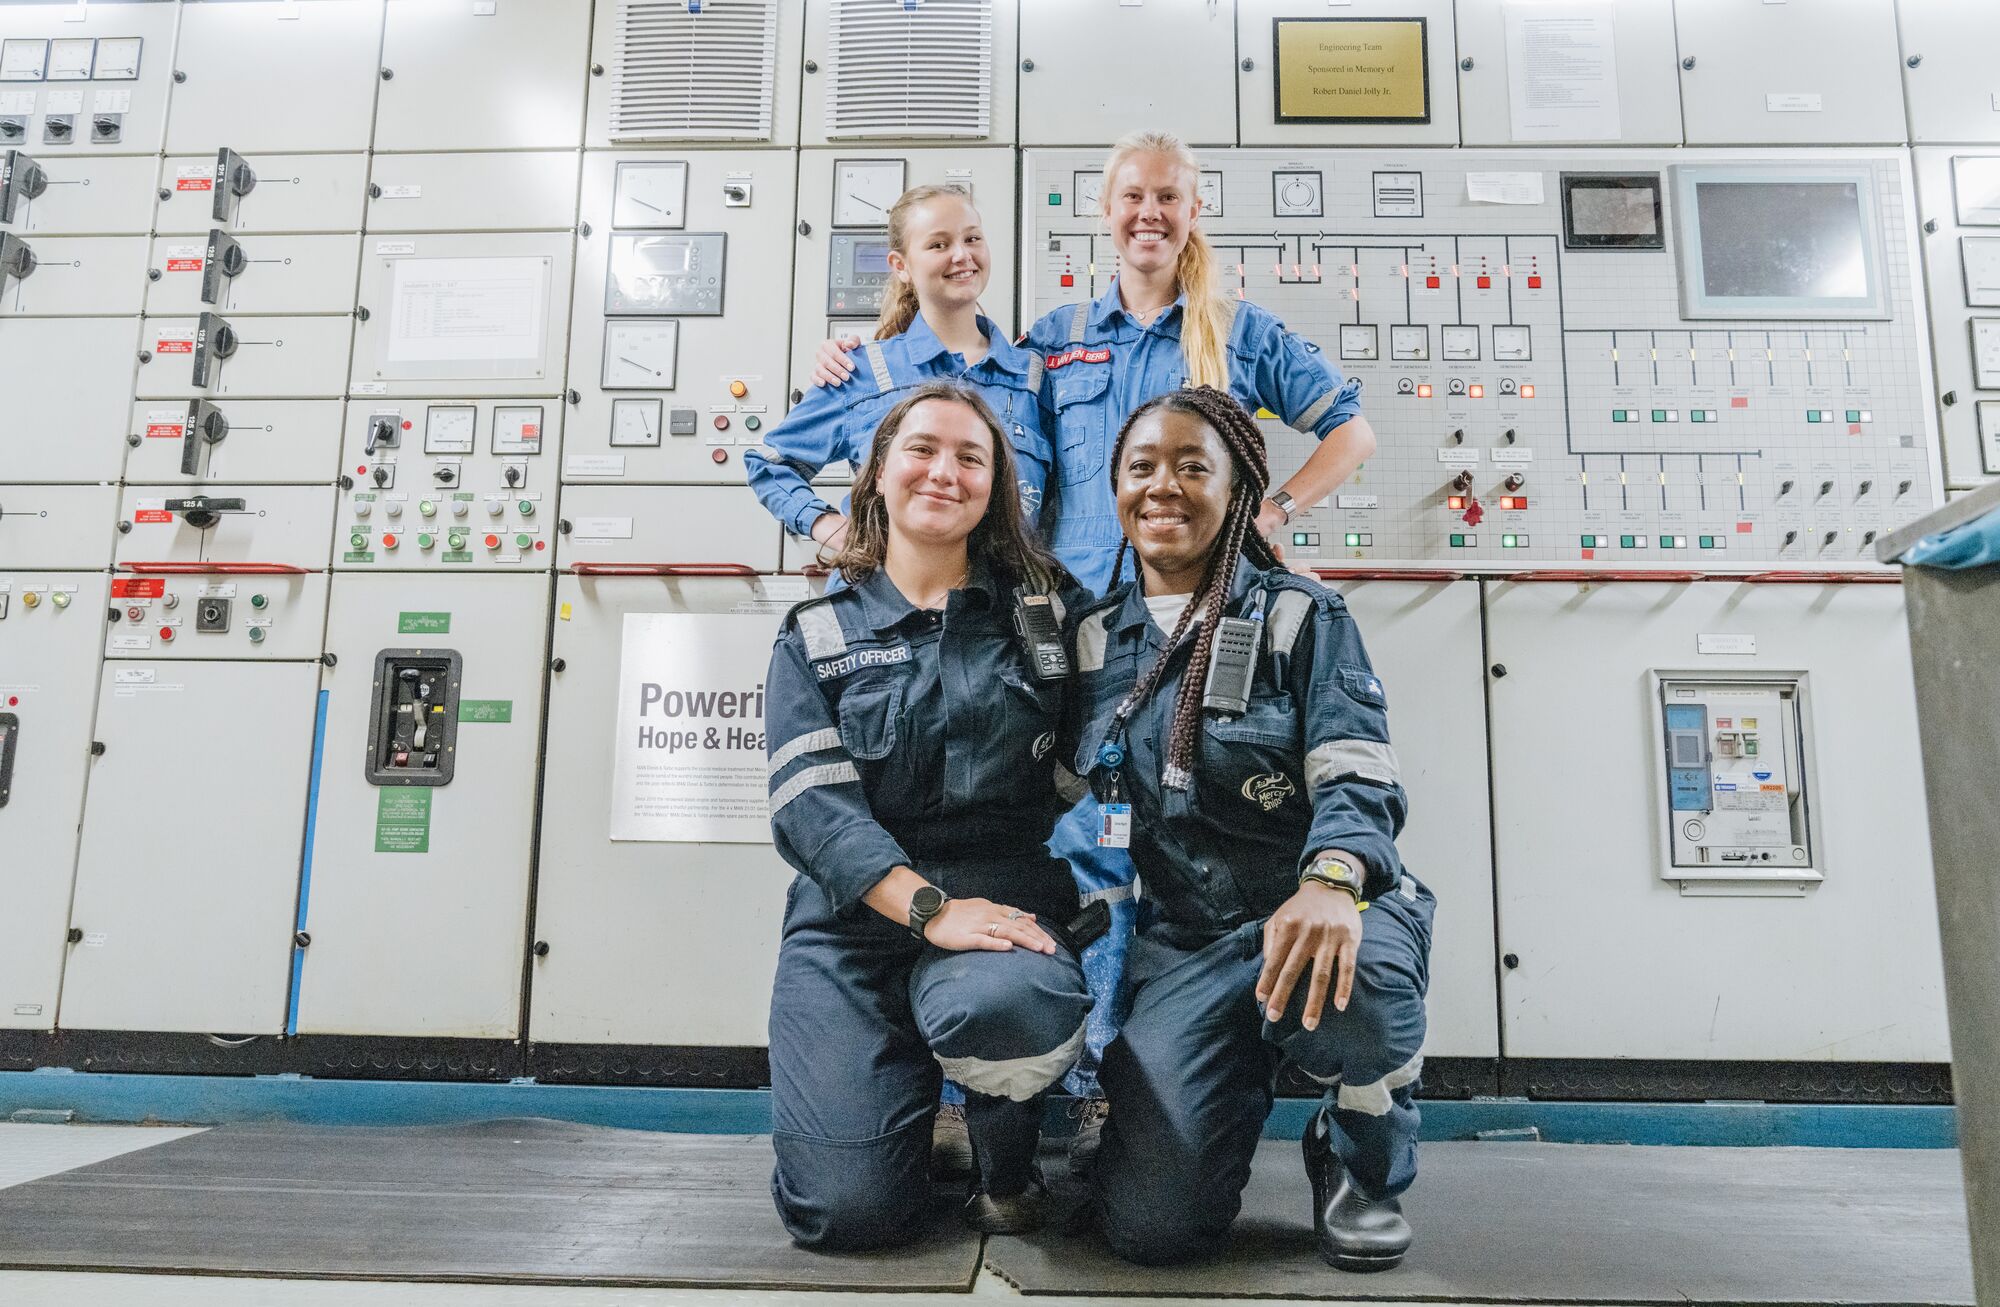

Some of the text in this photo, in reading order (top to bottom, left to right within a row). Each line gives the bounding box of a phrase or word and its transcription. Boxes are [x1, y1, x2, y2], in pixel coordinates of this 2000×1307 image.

[1319, 43, 1382, 52] Engineering Team
[1308, 65, 1395, 74] Sponsored in Memory of
[1313, 87, 1391, 97] Robert Daniel Jolly Jr.
[198, 329, 206, 342] 125
[1085, 351, 1106, 361] BERG
[188, 415, 196, 429] 125
[182, 500, 203, 508] 125 A
[817, 647, 907, 679] SAFETY OFFICER
[638, 726, 698, 754] Hope
[703, 727, 721, 750] &
[1258, 790, 1286, 803] Mercy
[1263, 798, 1283, 811] Ships
